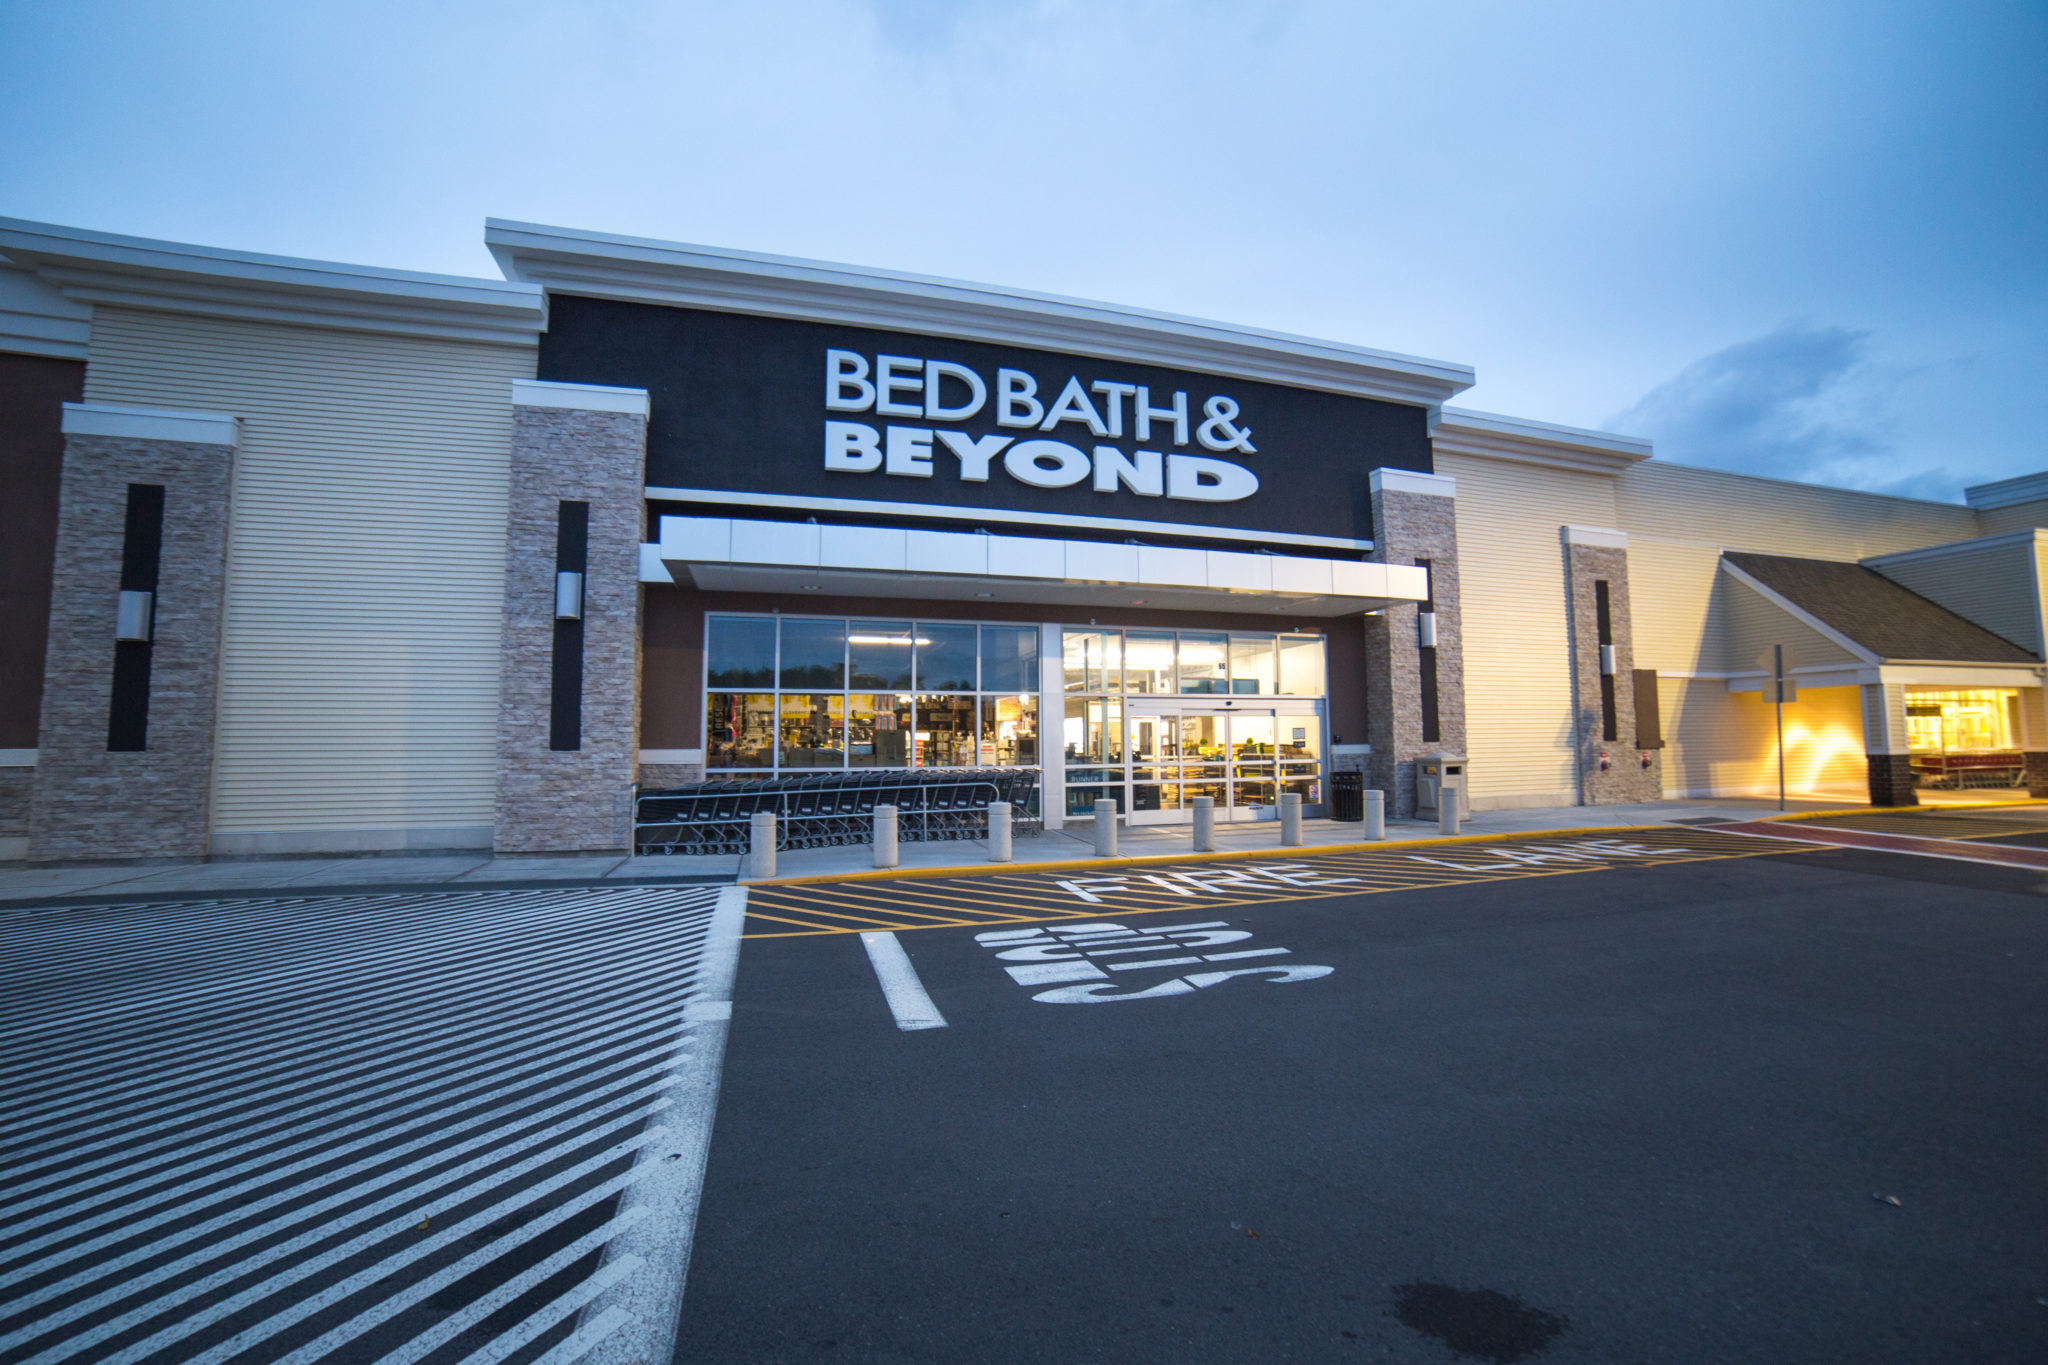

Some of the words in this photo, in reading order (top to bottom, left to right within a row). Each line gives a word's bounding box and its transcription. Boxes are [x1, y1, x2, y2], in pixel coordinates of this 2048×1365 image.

[826, 348, 987, 422] BED
[997, 367, 1189, 446] BATH
[1197, 395, 1257, 454] &
[824, 420, 1259, 502] BEYOND
[1055, 864, 1362, 903] FIRE
[1406, 839, 1692, 871] LANE
[974, 920, 1335, 1004] STOP
